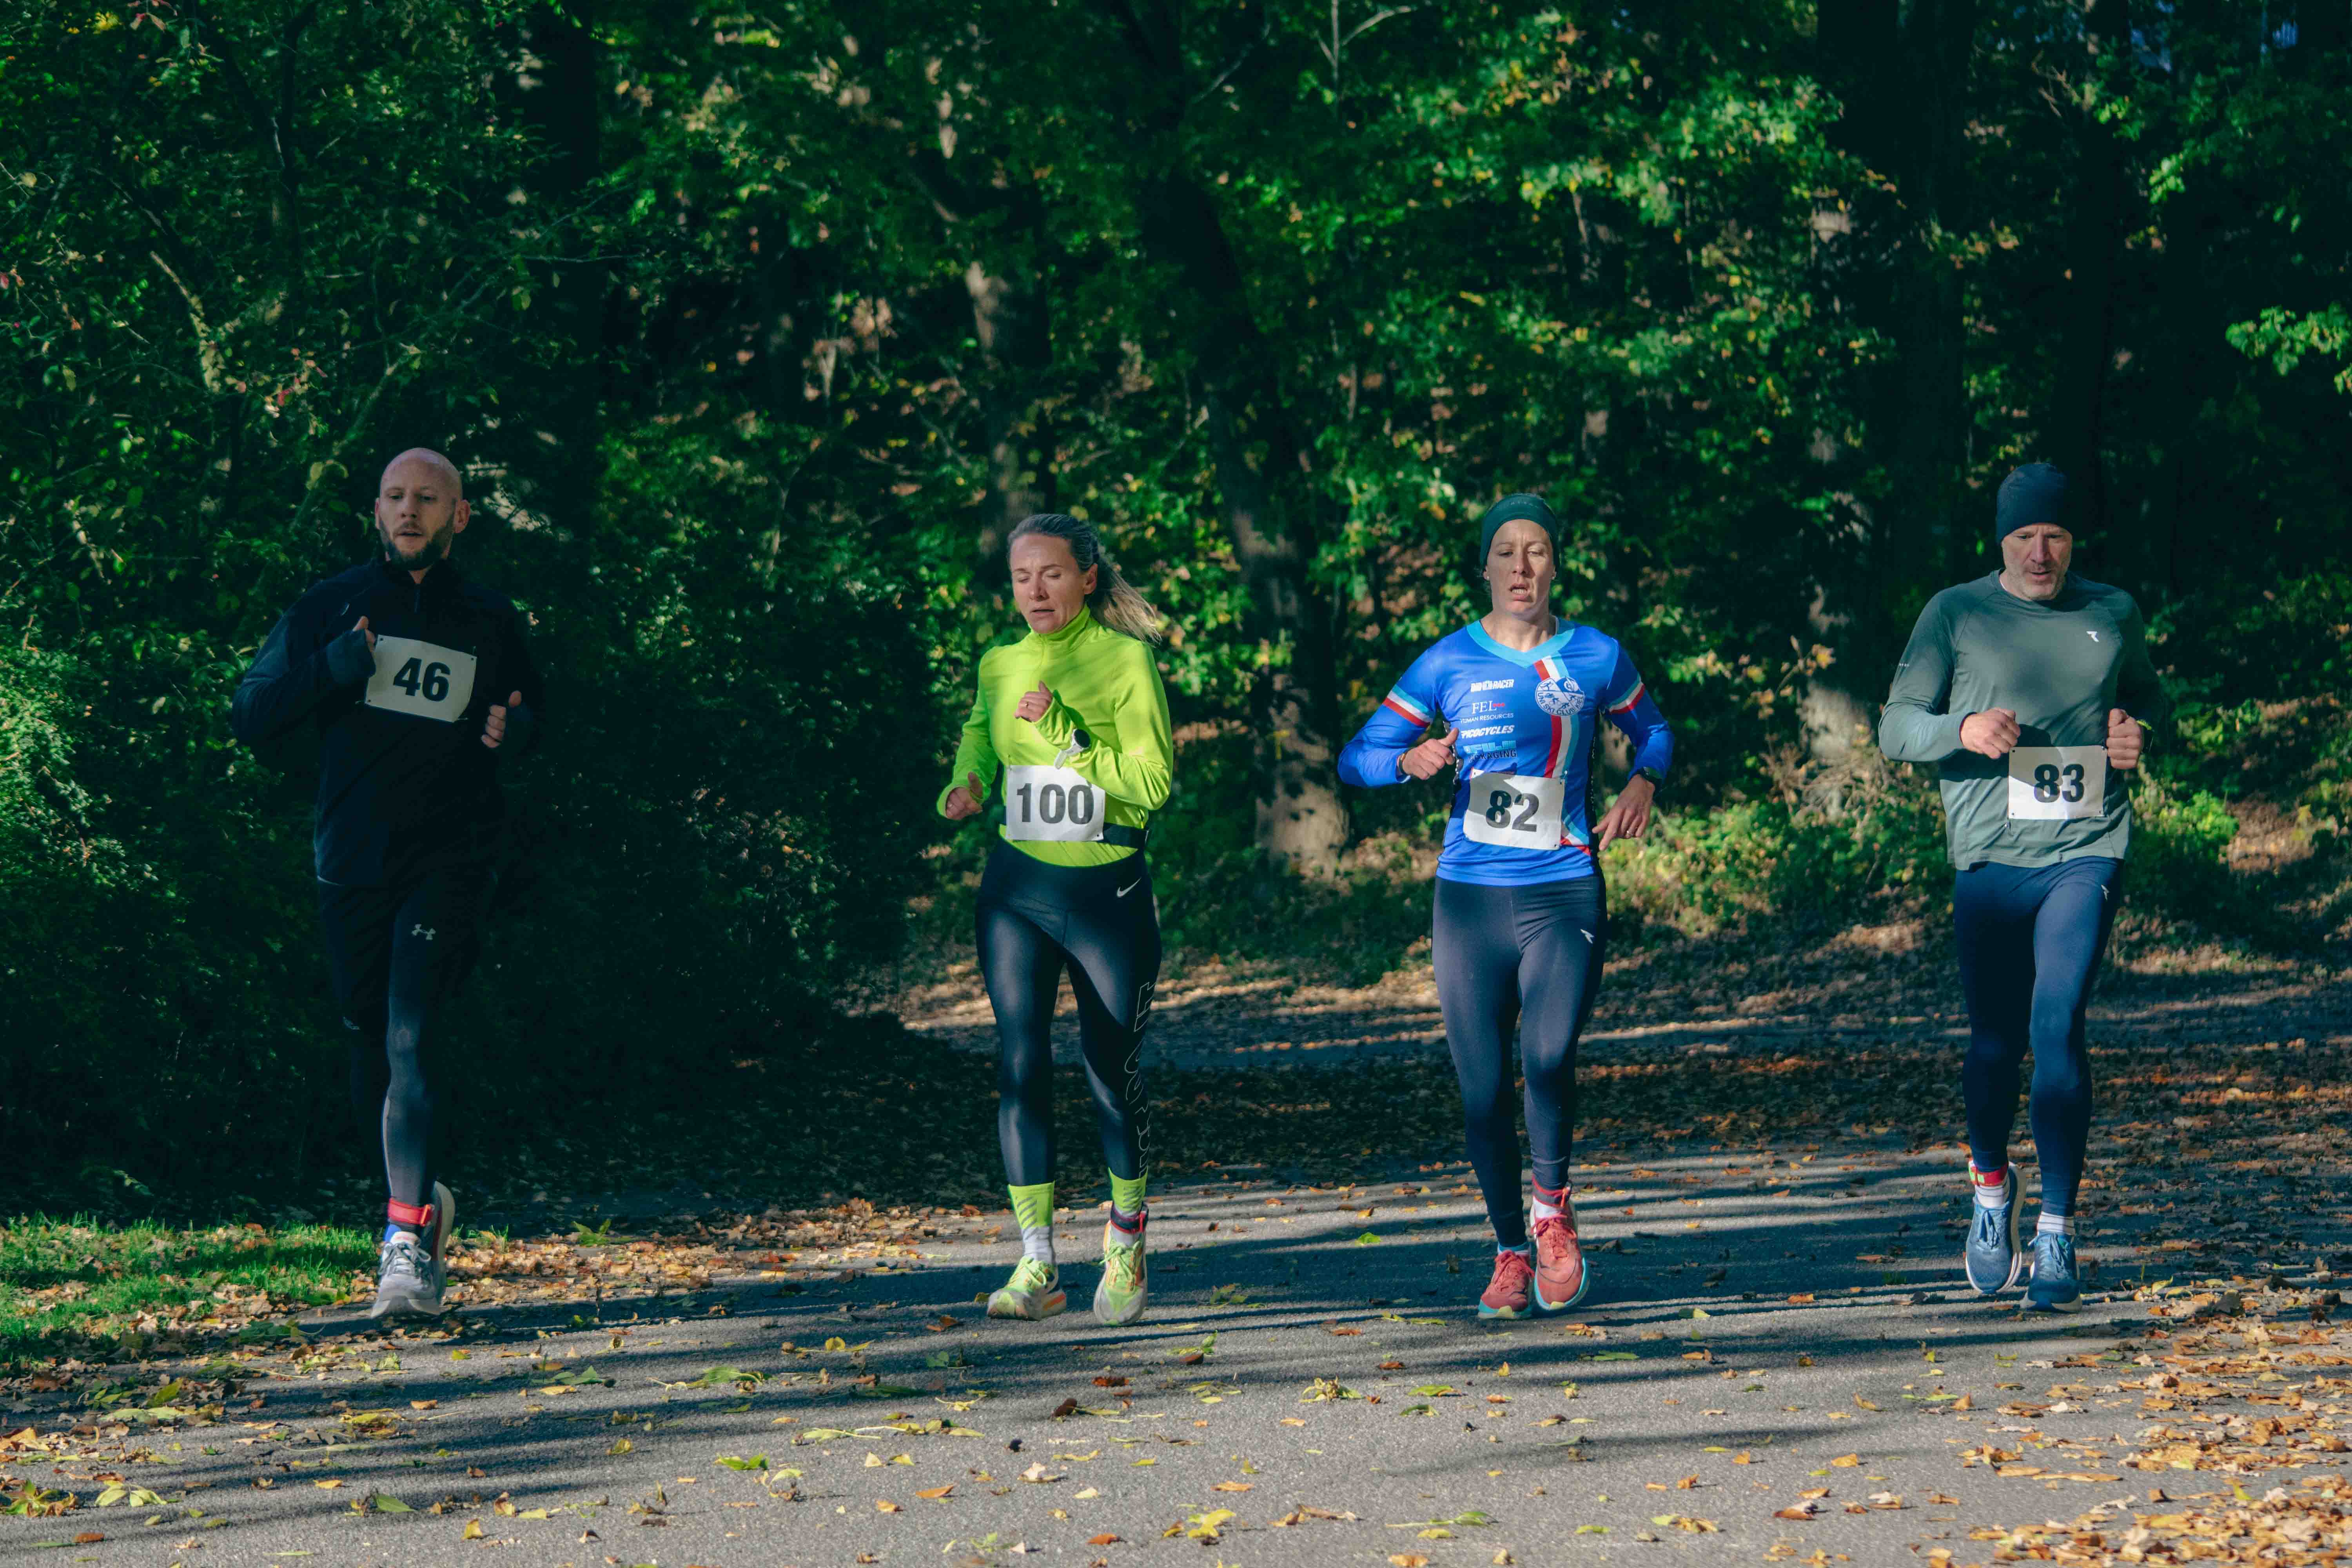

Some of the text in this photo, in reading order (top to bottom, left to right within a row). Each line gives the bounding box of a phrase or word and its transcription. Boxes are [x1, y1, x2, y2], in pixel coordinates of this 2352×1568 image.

[393, 657, 451, 702] 46
[1461, 715, 1479, 724] HUMAN
[1472, 701, 1497, 714] FEL
[1543, 704, 1555, 713] SKI
[1575, 696, 1584, 709] KIEL
[2034, 764, 2085, 803] 83
[1017, 783, 1094, 824] 100
[1486, 790, 1539, 832] 82
